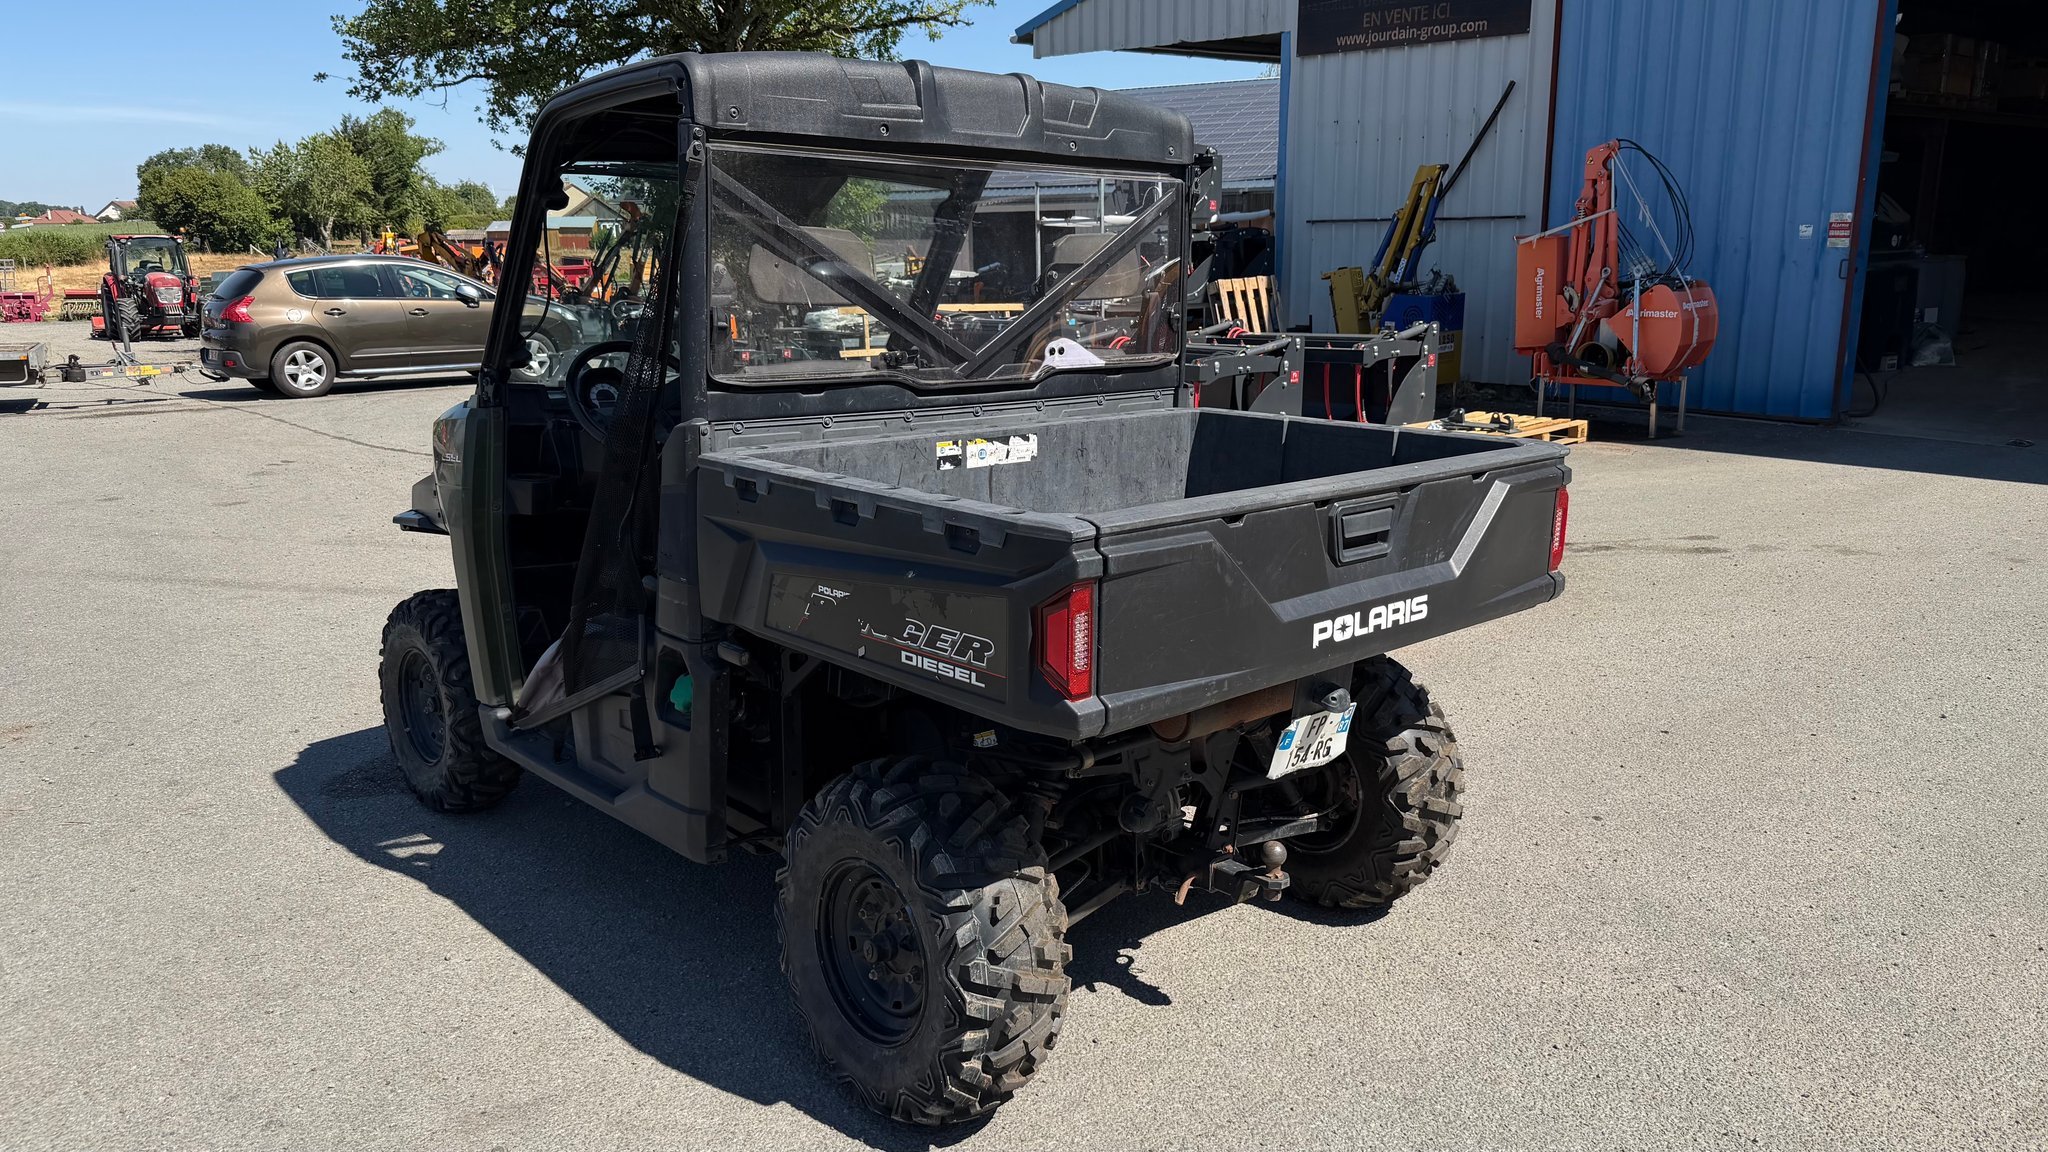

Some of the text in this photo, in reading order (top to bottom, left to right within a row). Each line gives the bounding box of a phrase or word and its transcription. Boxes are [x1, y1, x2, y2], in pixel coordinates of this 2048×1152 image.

[1336, 18, 1488, 47] www.jourdain-group.com
[1362, 12, 1382, 29] EN
[1384, 5, 1429, 25] VENTE
[1432, 3, 1451, 20] ICI
[1534, 267, 1545, 320] Agrimaster
[1625, 308, 1679, 319] Arimaster
[1312, 594, 1429, 649] POLARIS
[901, 650, 986, 688] DIESEL
